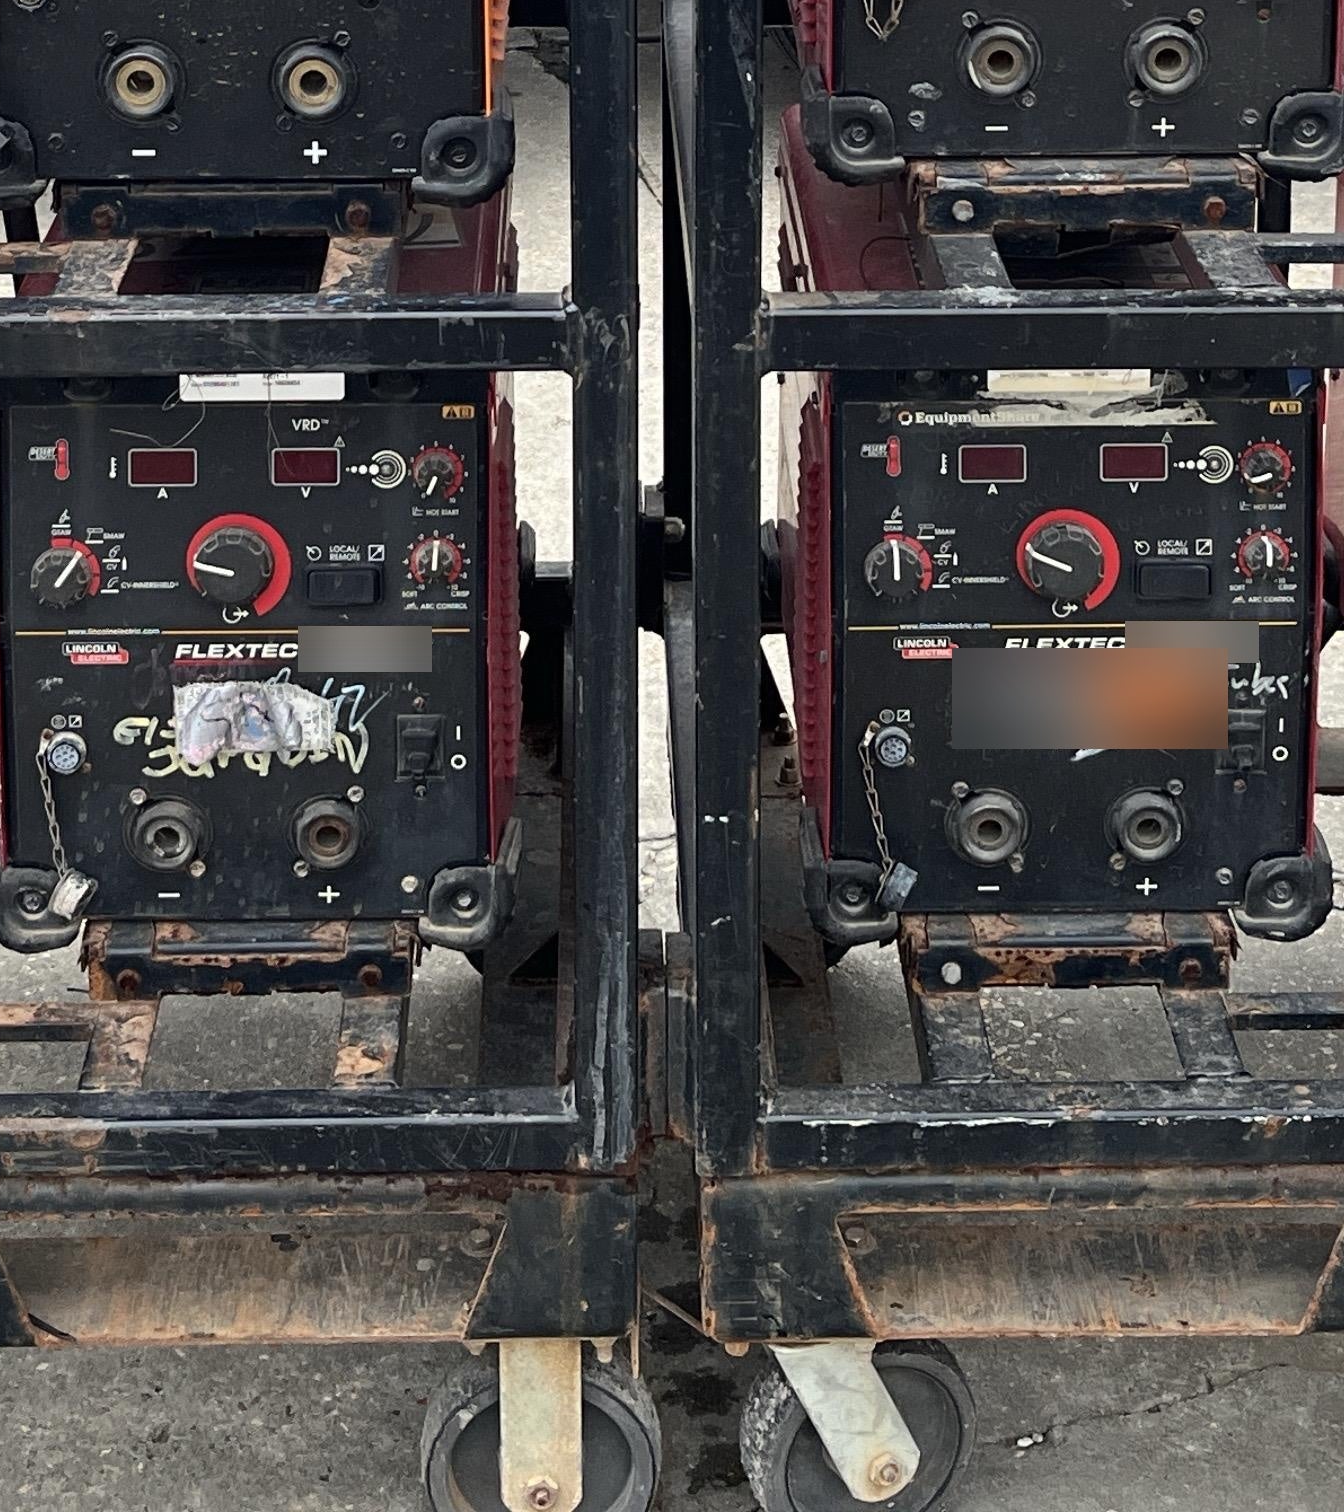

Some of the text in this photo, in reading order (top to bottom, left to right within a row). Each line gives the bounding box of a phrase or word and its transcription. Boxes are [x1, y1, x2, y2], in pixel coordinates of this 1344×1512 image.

[157, 488, 168, 498] A
[301, 487, 310, 498] V
[988, 484, 998, 495] A
[1129, 482, 1139, 493] V
[897, 639, 946, 648] LINCOLN
[1005, 637, 1125, 649] FLEXTEC
[66, 645, 116, 653] LINCOLN
[175, 643, 299, 659] FLEXTEC
